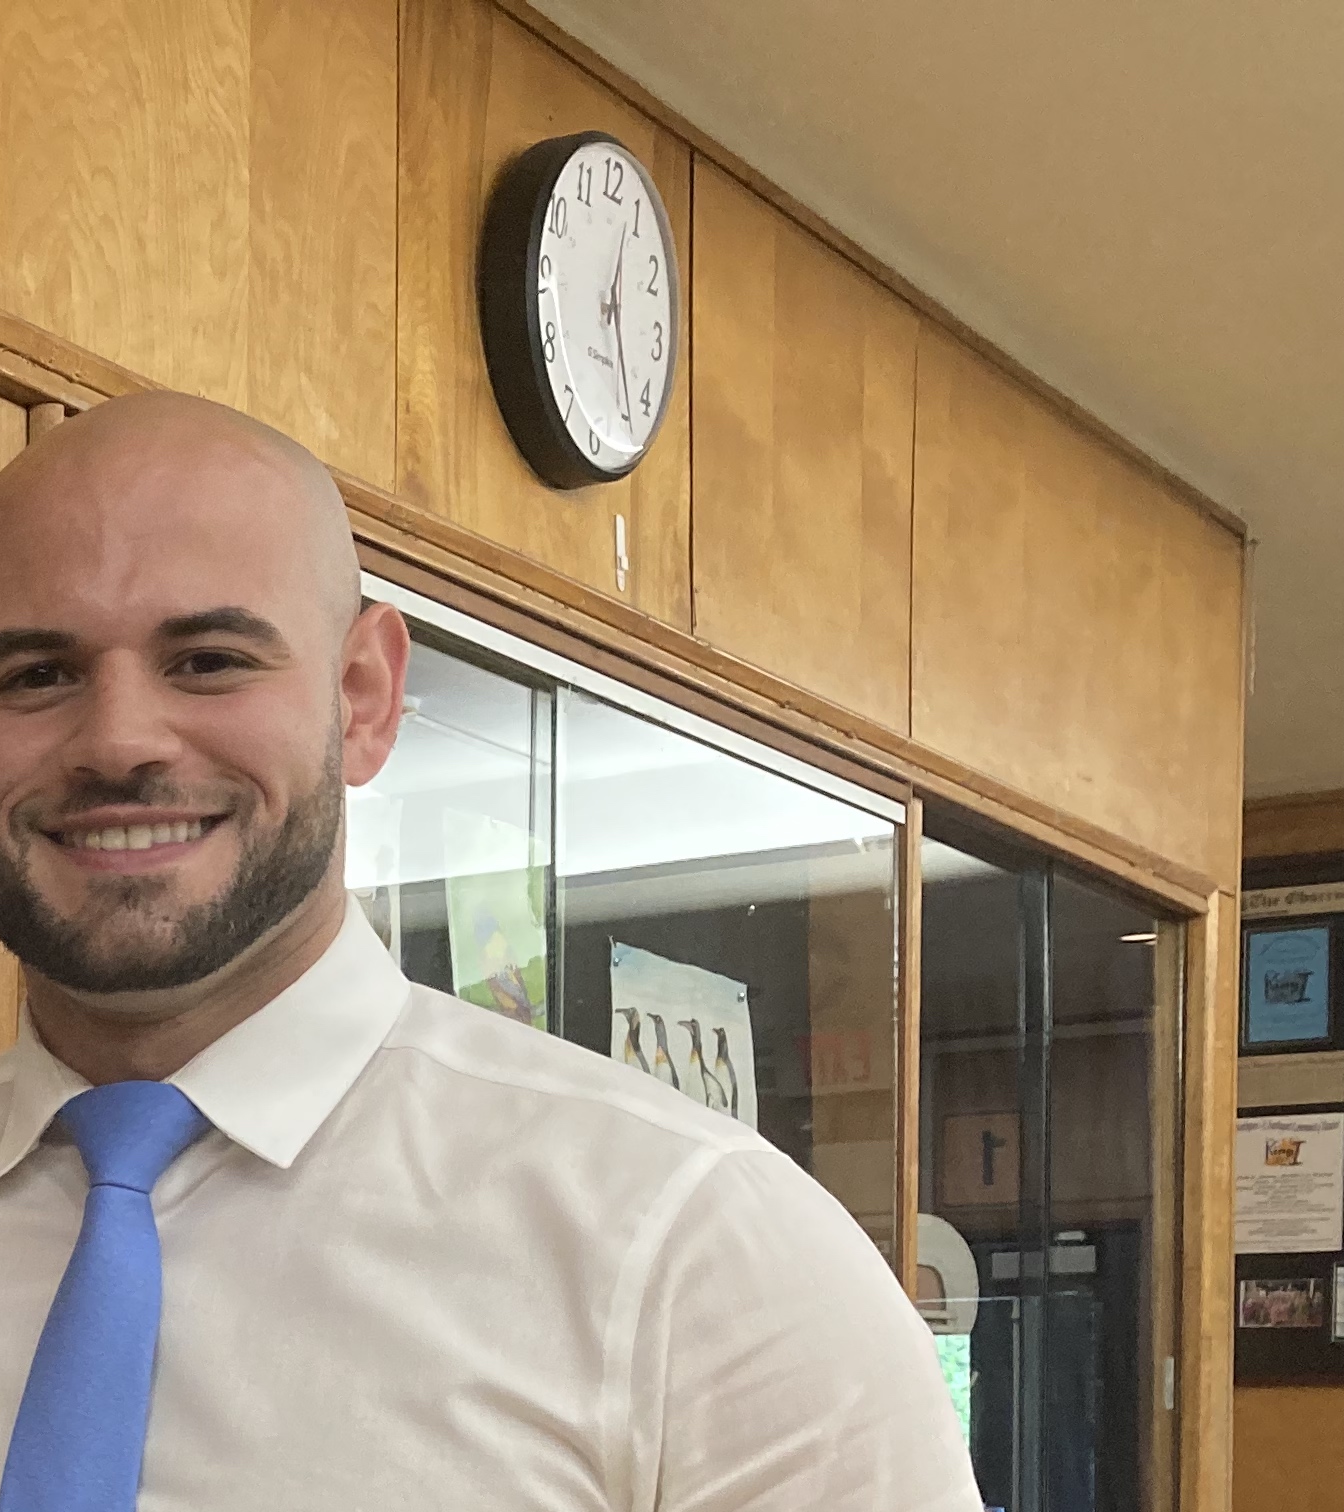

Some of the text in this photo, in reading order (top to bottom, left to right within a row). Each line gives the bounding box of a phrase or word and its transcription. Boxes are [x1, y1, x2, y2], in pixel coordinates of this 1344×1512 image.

[576, 156, 624, 208] 11 12
[547, 193, 641, 239] 10 1
[646, 254, 659, 297] 2
[543, 320, 663, 363] 8 3
[563, 377, 652, 425] 7 4
